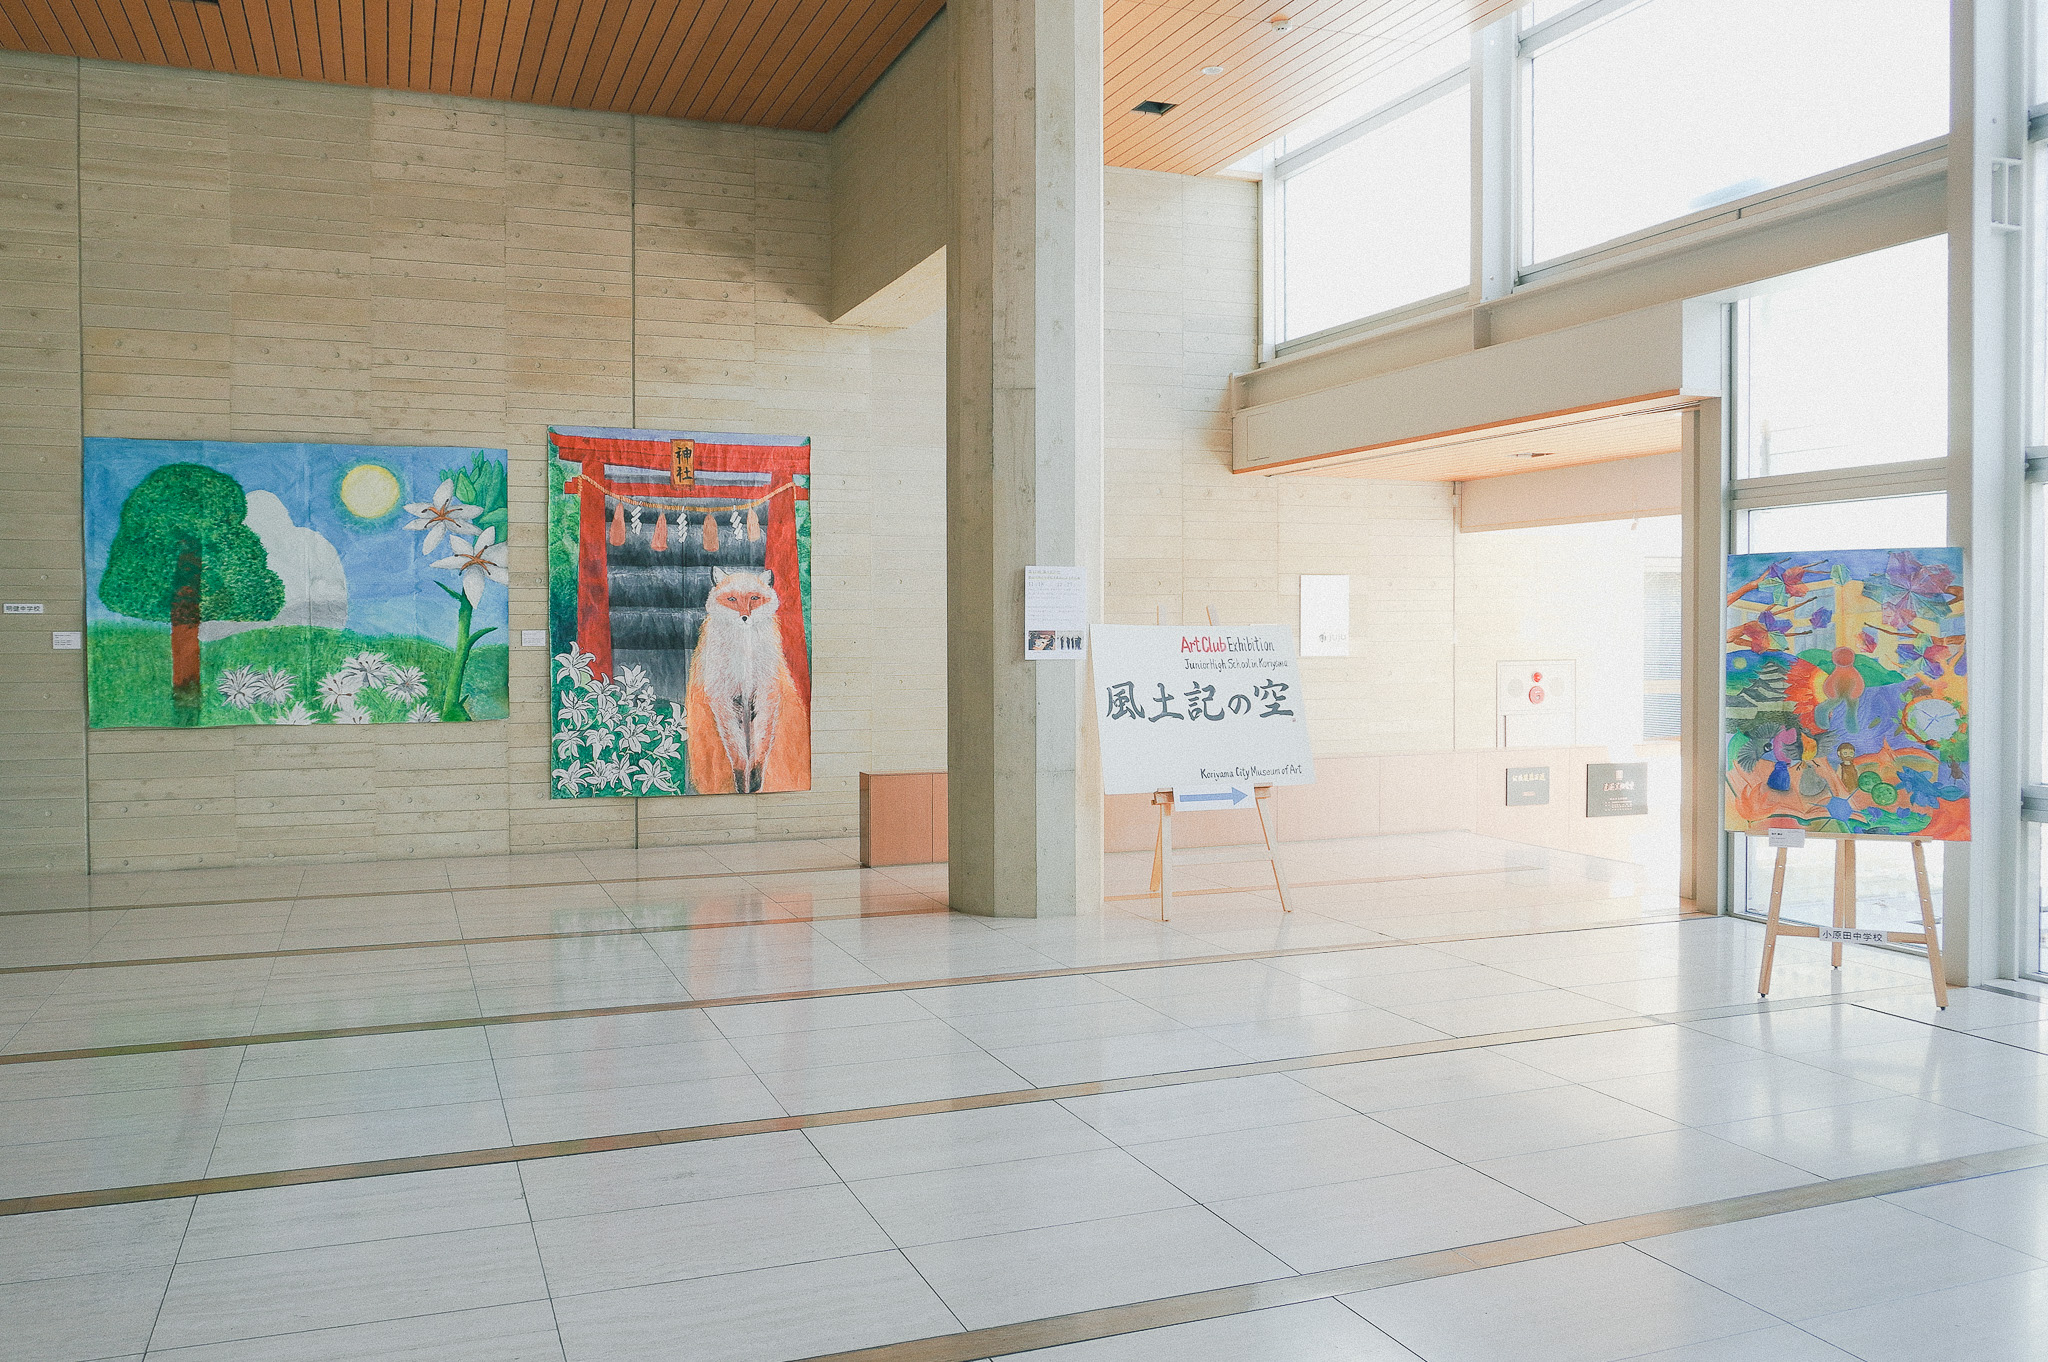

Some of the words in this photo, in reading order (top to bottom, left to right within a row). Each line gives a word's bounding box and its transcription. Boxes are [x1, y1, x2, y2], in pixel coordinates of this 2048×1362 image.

[675, 447, 693, 482] 神社
[1181, 636, 1201, 653] Art
[1202, 636, 1226, 653] Club
[1226, 636, 1275, 652] Exhibition
[1184, 658, 1209, 670] Junior
[1209, 658, 1227, 672] High
[1227, 658, 1250, 669] School
[1251, 659, 1258, 668] in
[1258, 658, 1288, 671] Koriyama
[1106, 678, 1294, 724] 風土記の空
[1200, 768, 1235, 781] Koriyama
[1235, 766, 1249, 780] City
[1250, 765, 1280, 777] Museum
[1281, 765, 1289, 775] of
[1289, 764, 1302, 774] Art
[1821, 929, 1883, 943] 小原田中学校
